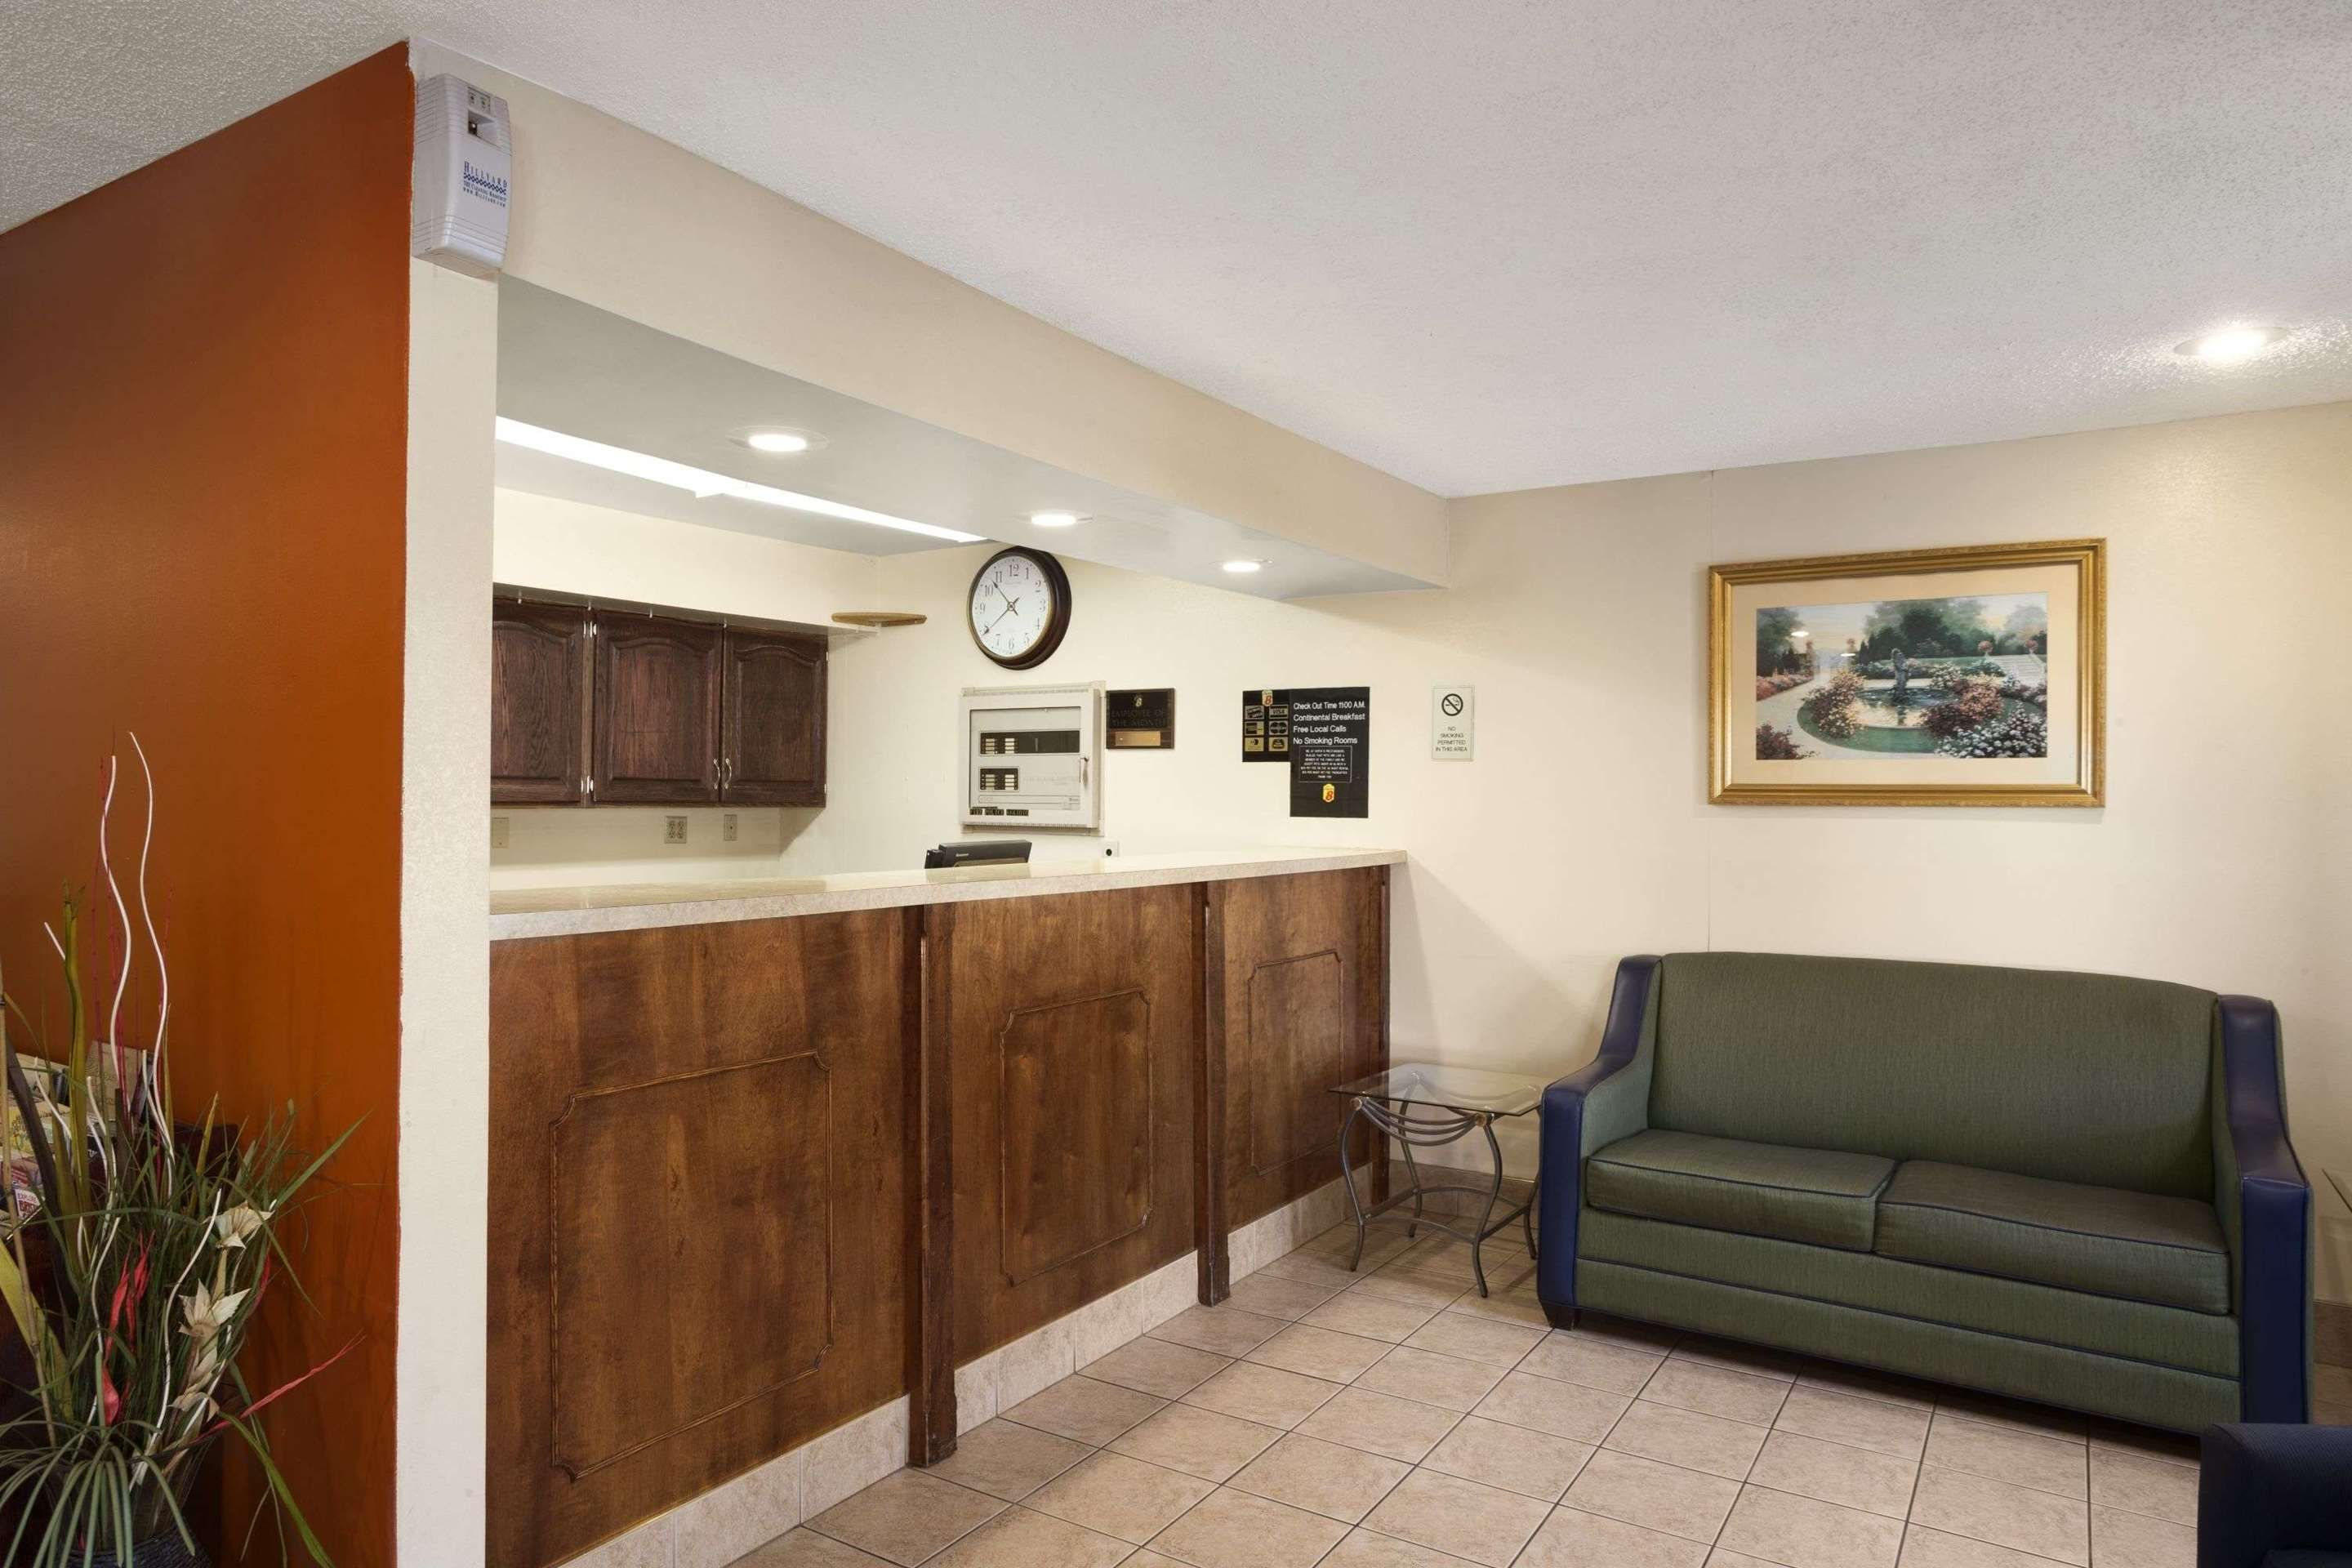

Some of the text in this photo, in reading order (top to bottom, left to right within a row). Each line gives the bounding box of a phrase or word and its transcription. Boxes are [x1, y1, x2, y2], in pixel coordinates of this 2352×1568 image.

[463, 161, 508, 189] HILLYARD
[1009, 564, 1020, 577] 12
[1025, 567, 1030, 581] 1
[995, 571, 1003, 584] 11
[984, 585, 994, 598] 10
[1035, 580, 1042, 593] 2
[1135, 697, 1143, 707] 8
[1312, 702, 1322, 710] Out
[1293, 713, 1365, 722] Continental Breakfast
[1293, 725, 1309, 733] Free
[1330, 724, 1347, 733] Calls
[1304, 737, 1333, 746] Smoking
[1334, 737, 1358, 745] Rooms
[1325, 791, 1334, 801] 8
